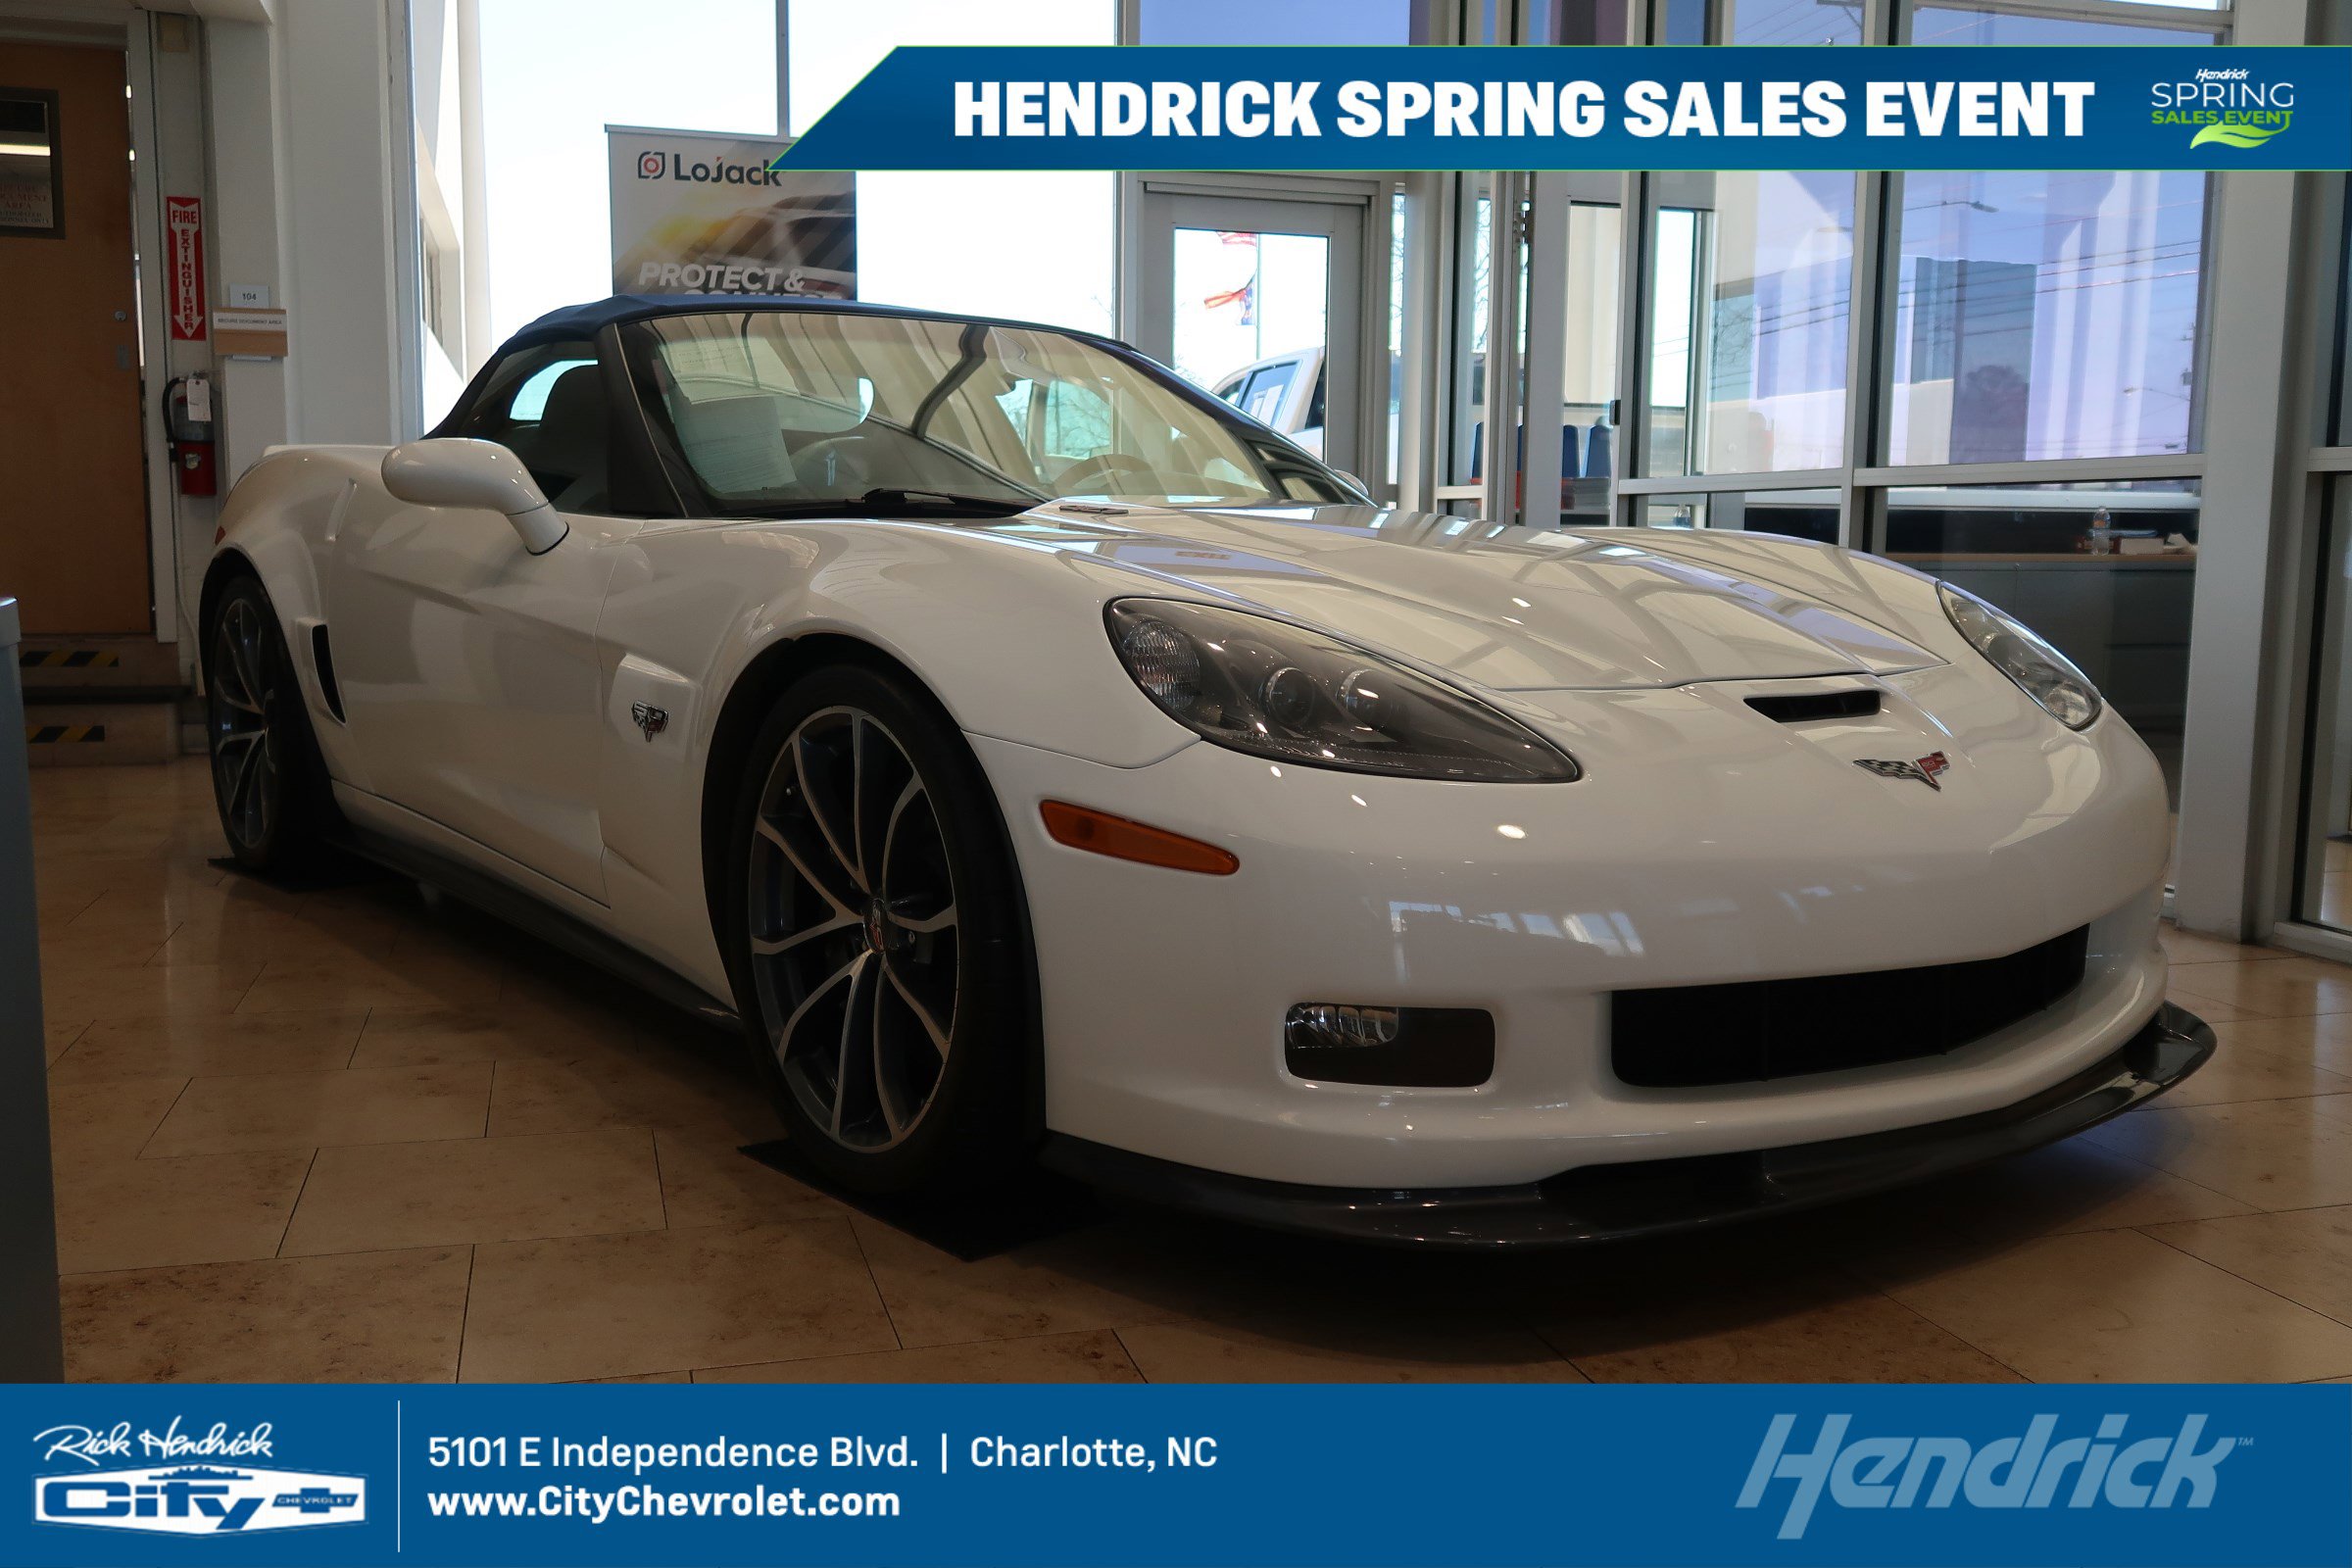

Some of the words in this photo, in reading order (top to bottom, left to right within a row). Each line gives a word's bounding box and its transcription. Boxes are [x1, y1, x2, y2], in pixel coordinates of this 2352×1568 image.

[172, 210, 197, 224] FIRE
[180, 228, 194, 330] EXTINGUISHER
[638, 261, 784, 291] PROTECT
[784, 269, 806, 293] &
[242, 292, 257, 301] 104
